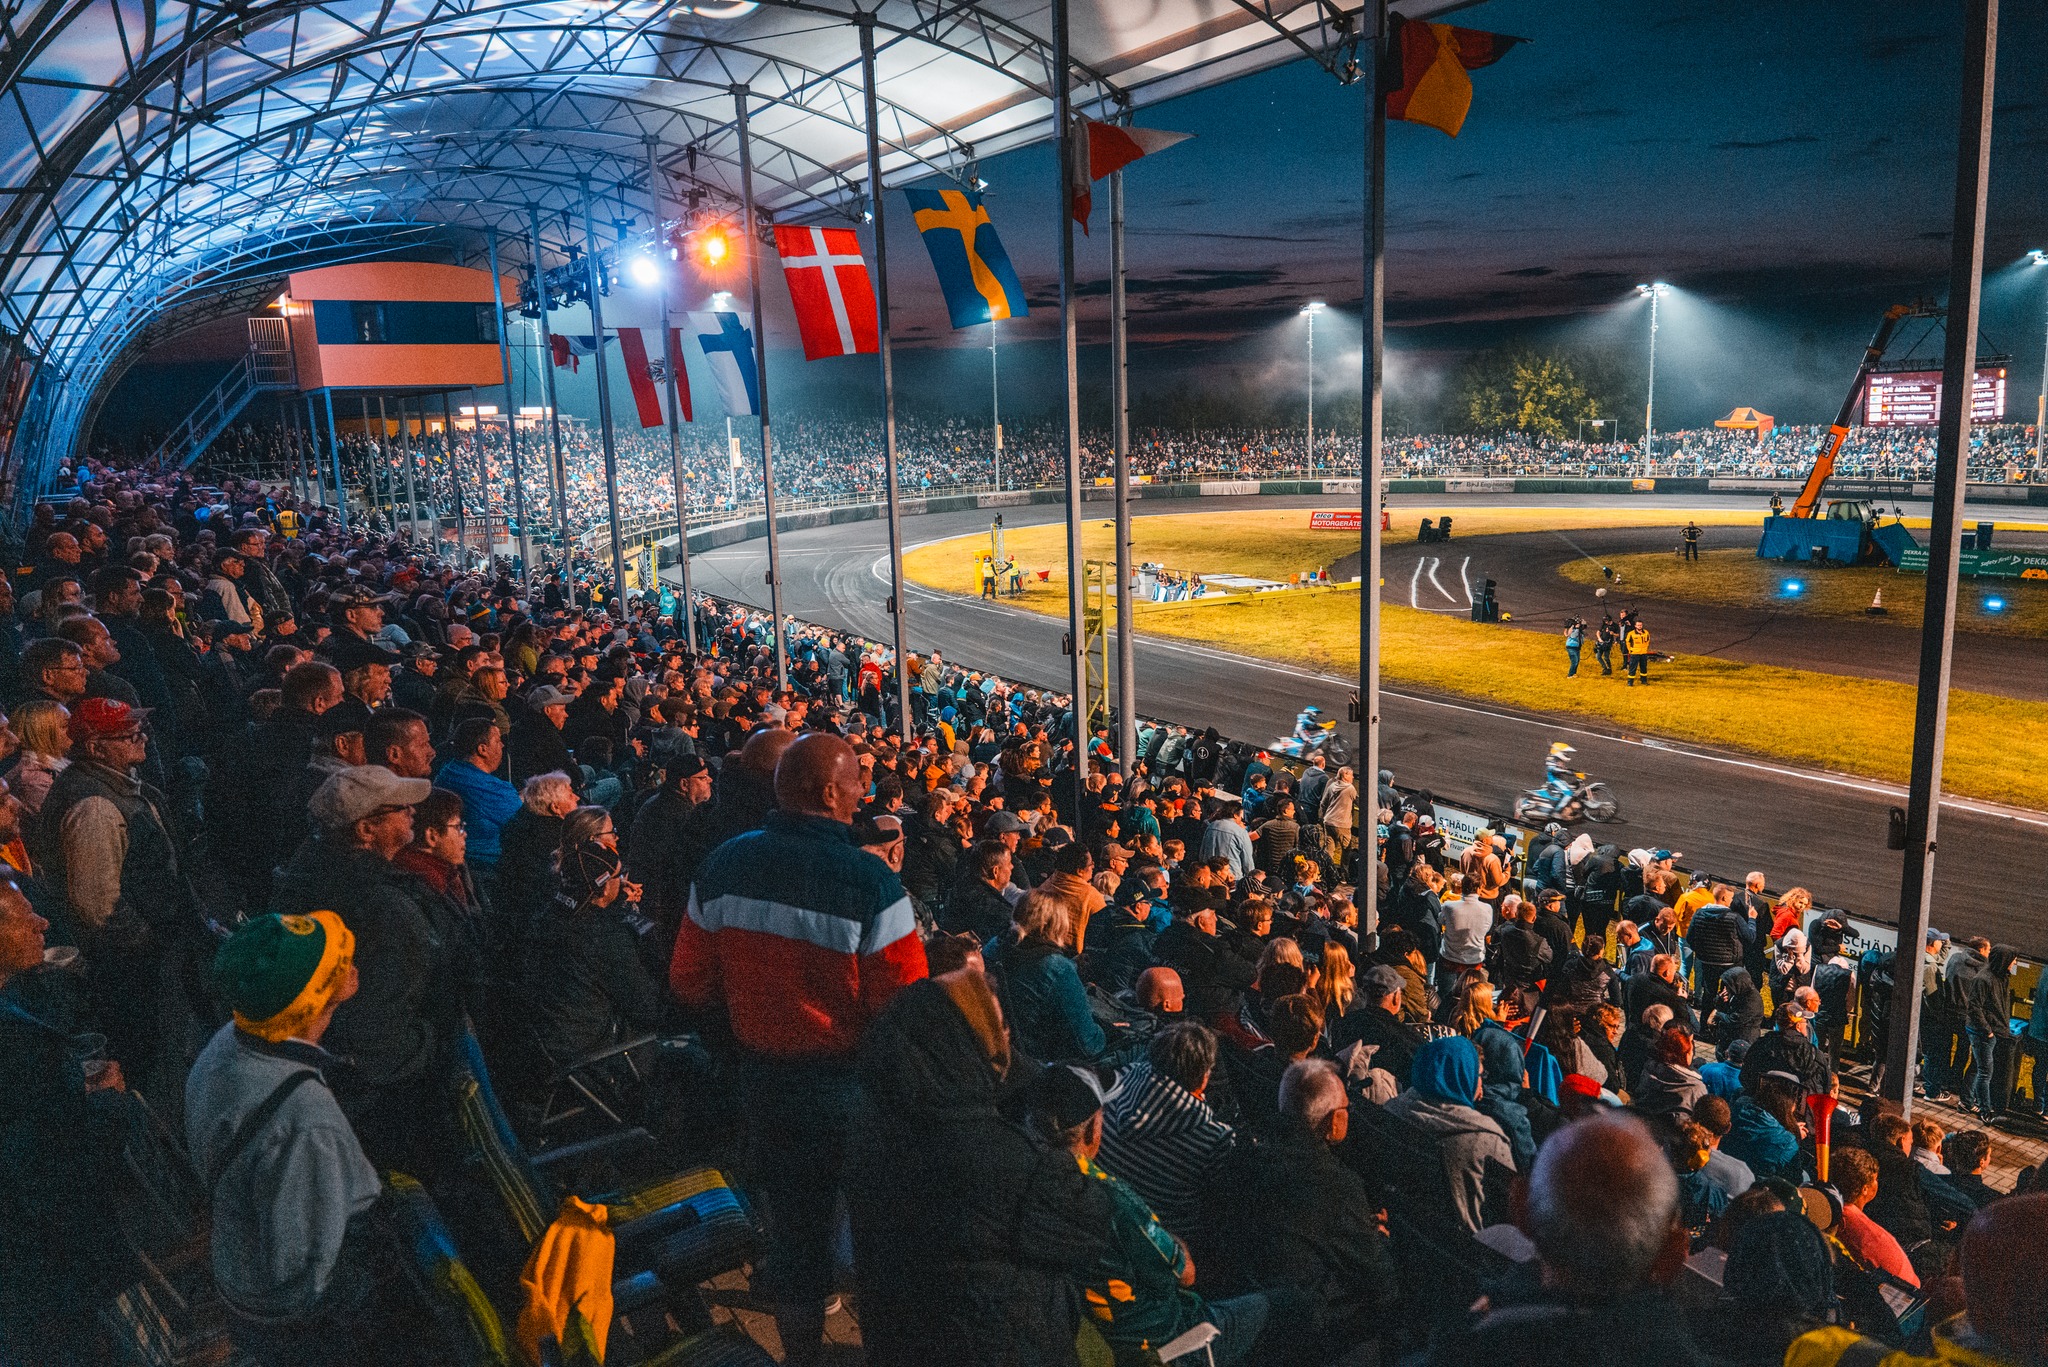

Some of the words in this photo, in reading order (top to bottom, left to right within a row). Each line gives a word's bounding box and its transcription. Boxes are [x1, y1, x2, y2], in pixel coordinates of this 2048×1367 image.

[1822, 434, 1837, 458] JCB
[1438, 816, 1478, 835] SHÄDLI
[1843, 934, 1897, 954] SCHÄD
